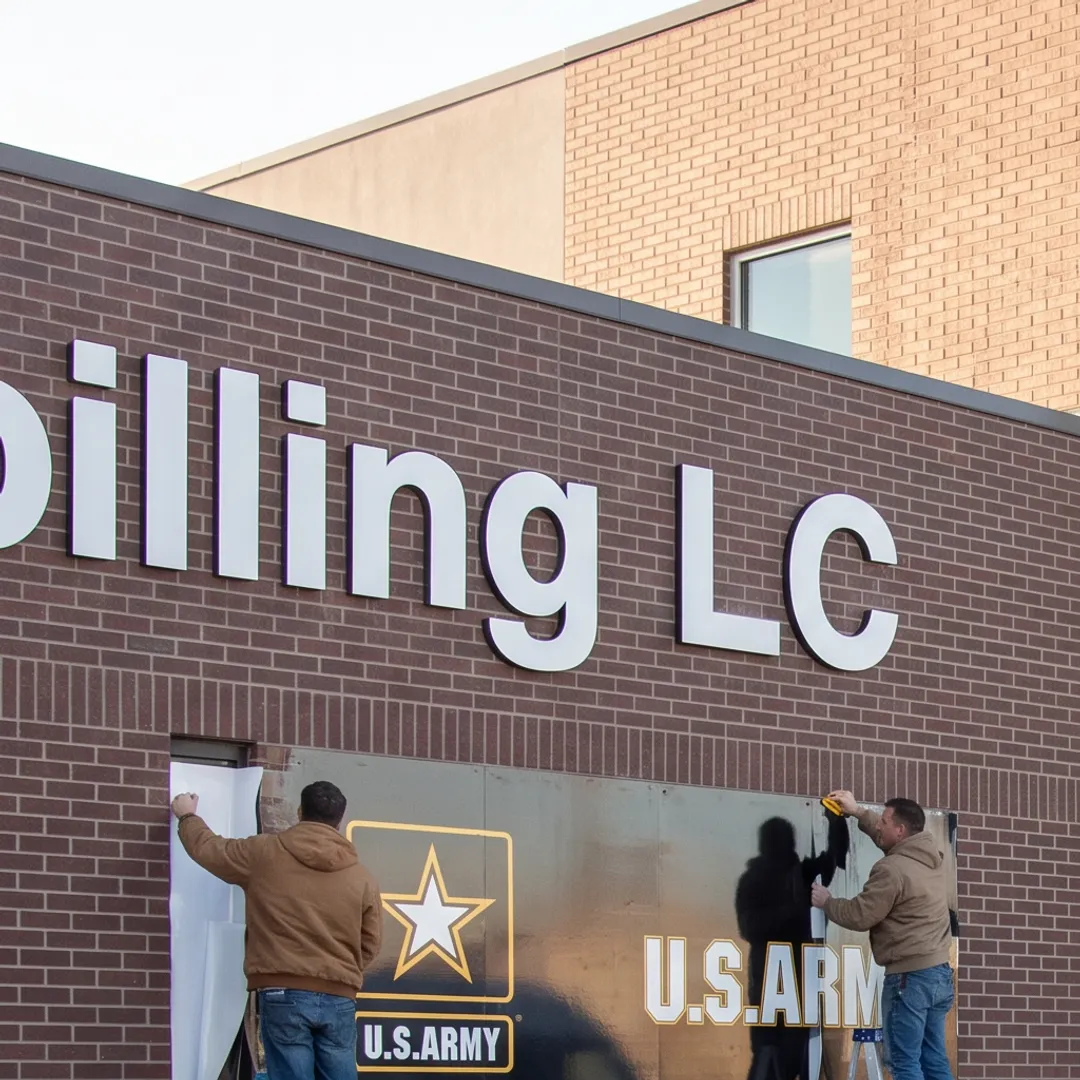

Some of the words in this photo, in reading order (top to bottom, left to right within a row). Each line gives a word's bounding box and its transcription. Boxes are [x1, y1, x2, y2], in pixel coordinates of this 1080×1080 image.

[675, 463, 899, 672] LC
[644, 934, 884, 1029] U.S.ARM
[363, 1024, 501, 1061] U.S.ARMY
